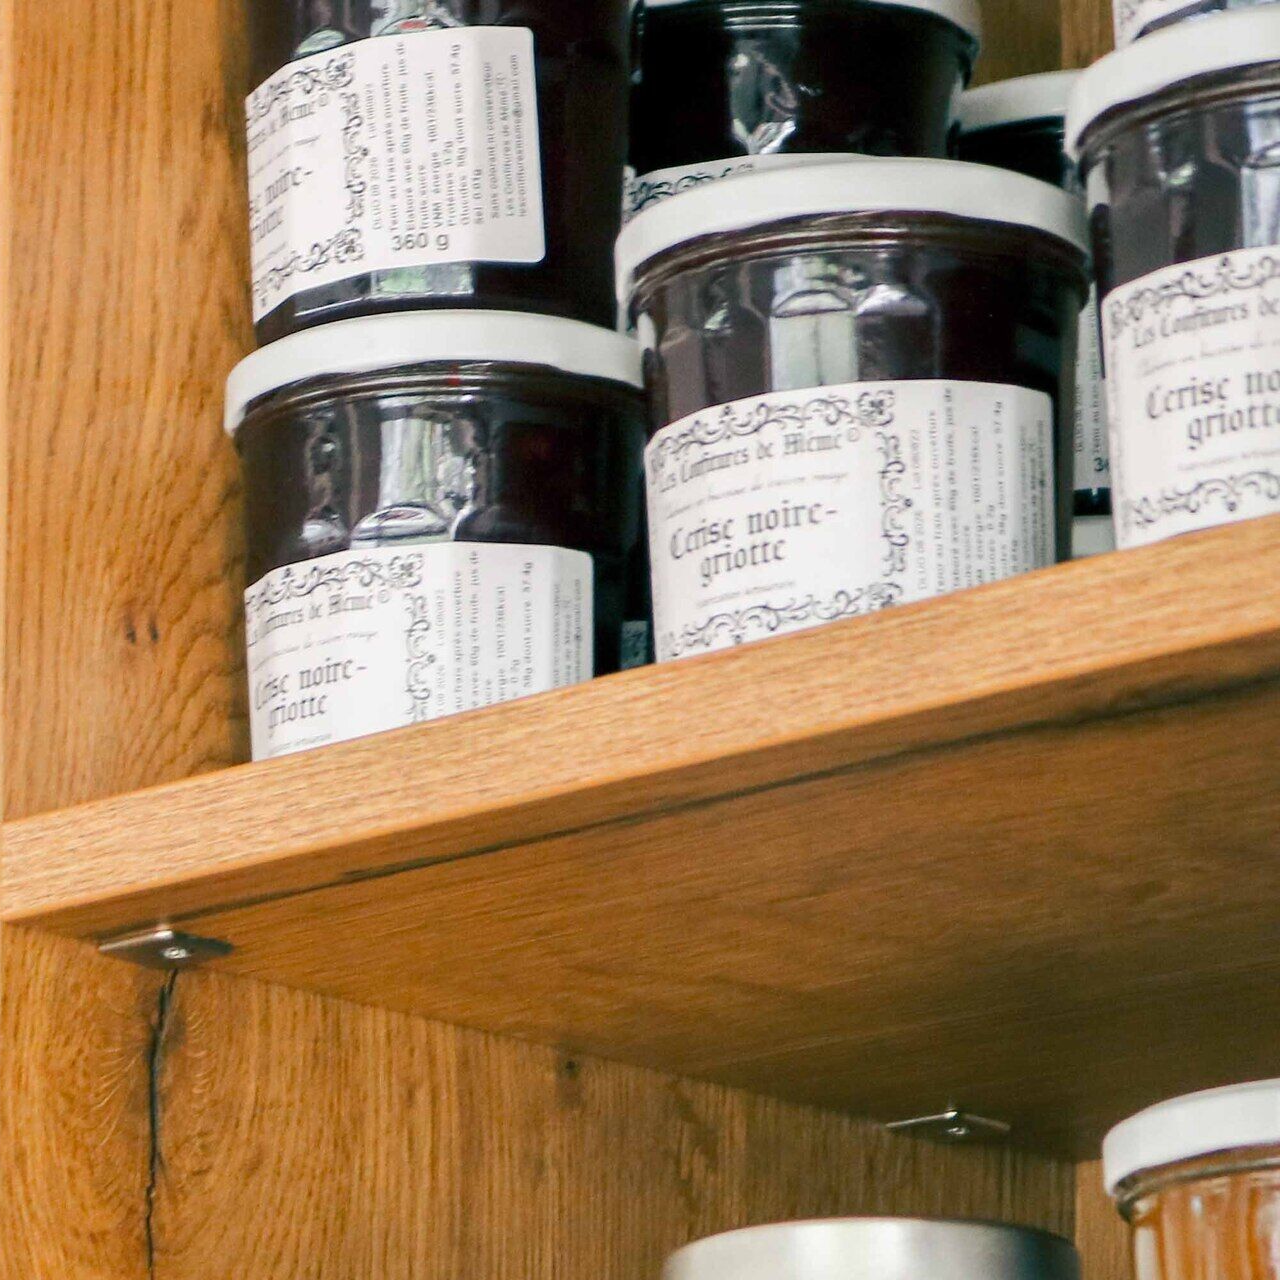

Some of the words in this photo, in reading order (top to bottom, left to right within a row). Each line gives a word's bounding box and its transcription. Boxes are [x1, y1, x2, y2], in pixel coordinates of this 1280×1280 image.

[381, 64, 392, 118] ouverture
[391, 233, 429, 252] 360
[1145, 376, 1230, 420] Cerise
